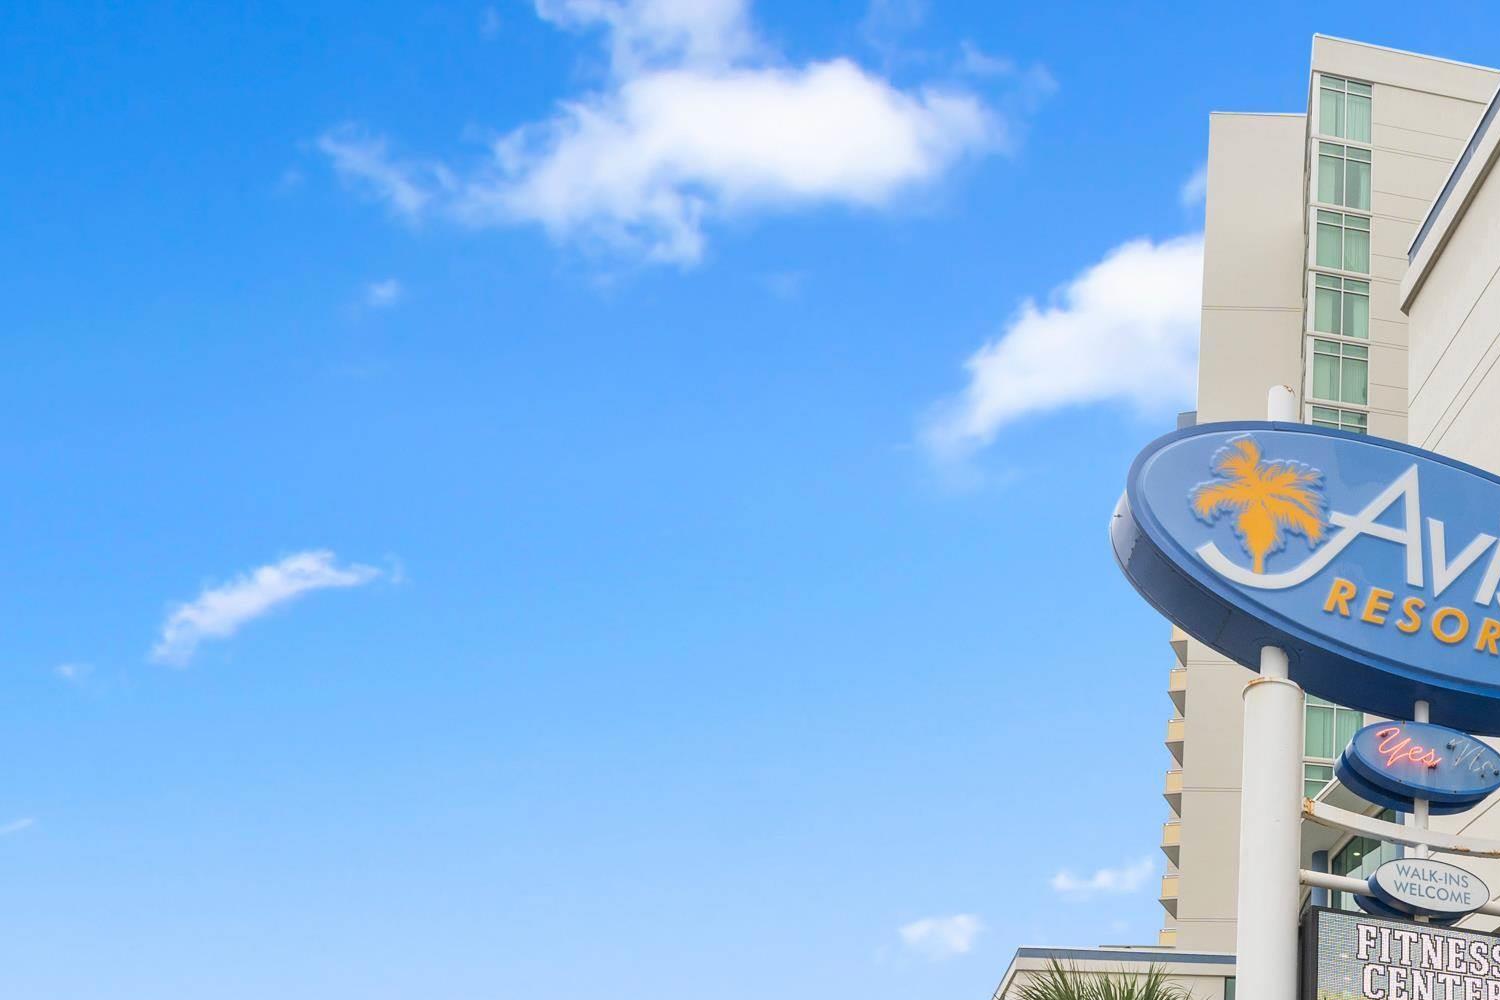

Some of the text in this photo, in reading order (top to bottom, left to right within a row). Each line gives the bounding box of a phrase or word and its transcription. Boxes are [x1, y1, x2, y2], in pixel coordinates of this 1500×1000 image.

[1376, 727, 1442, 768] Yes
[1395, 863, 1469, 889] WALK-INS
[1393, 879, 1471, 905] WELCOME
